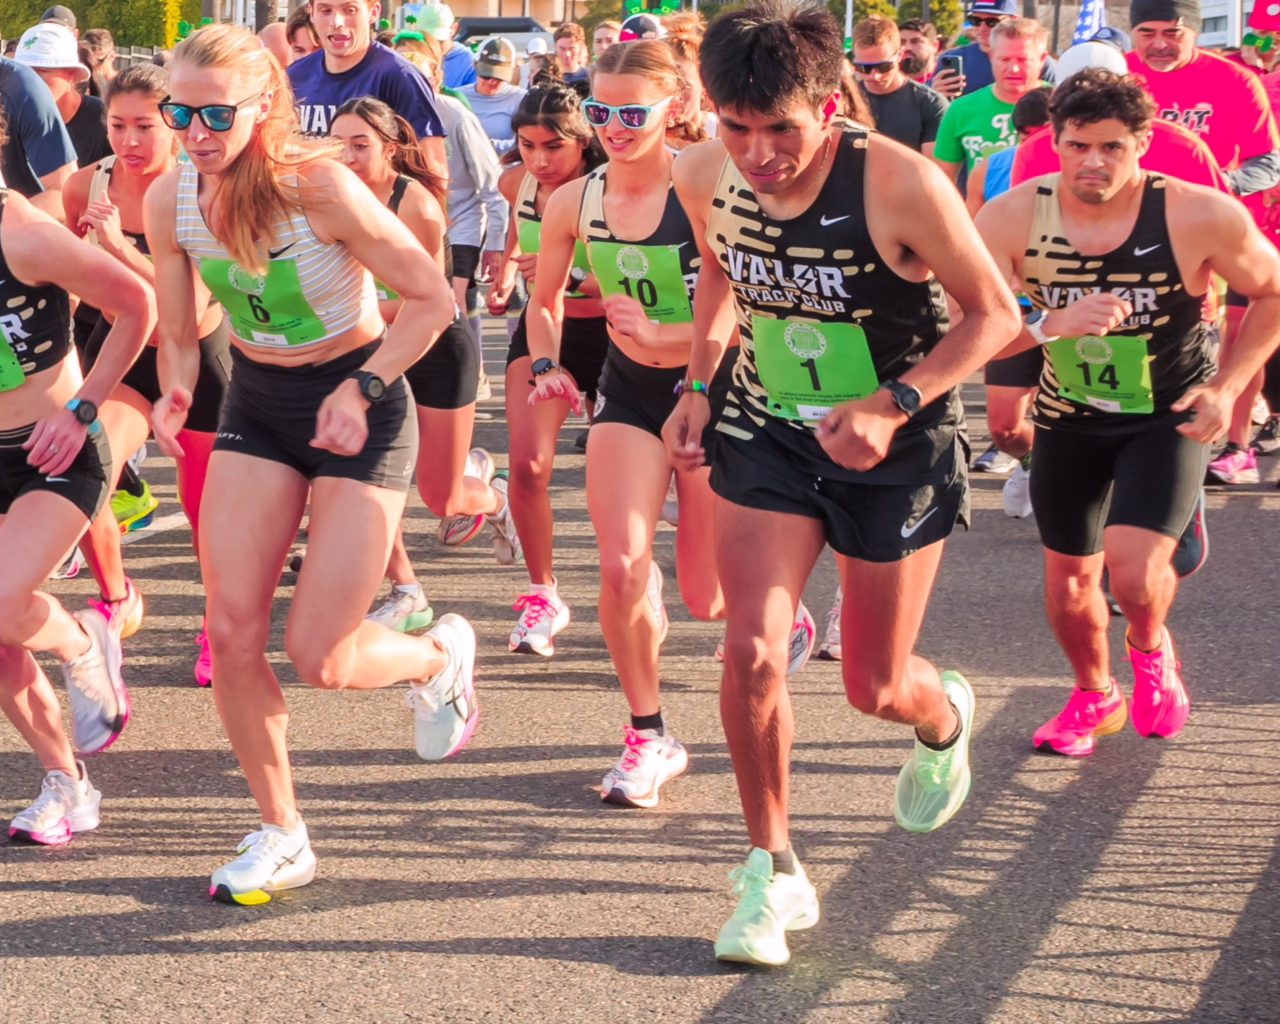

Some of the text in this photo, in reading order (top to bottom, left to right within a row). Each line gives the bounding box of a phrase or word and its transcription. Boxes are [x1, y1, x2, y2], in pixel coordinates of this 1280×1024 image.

[725, 245, 852, 298] VALOR
[617, 276, 658, 307] 10
[737, 285, 846, 313] TRACK CLUB
[247, 293, 270, 323] 6
[800, 358, 821, 391] 1
[1076, 362, 1120, 390] 14
